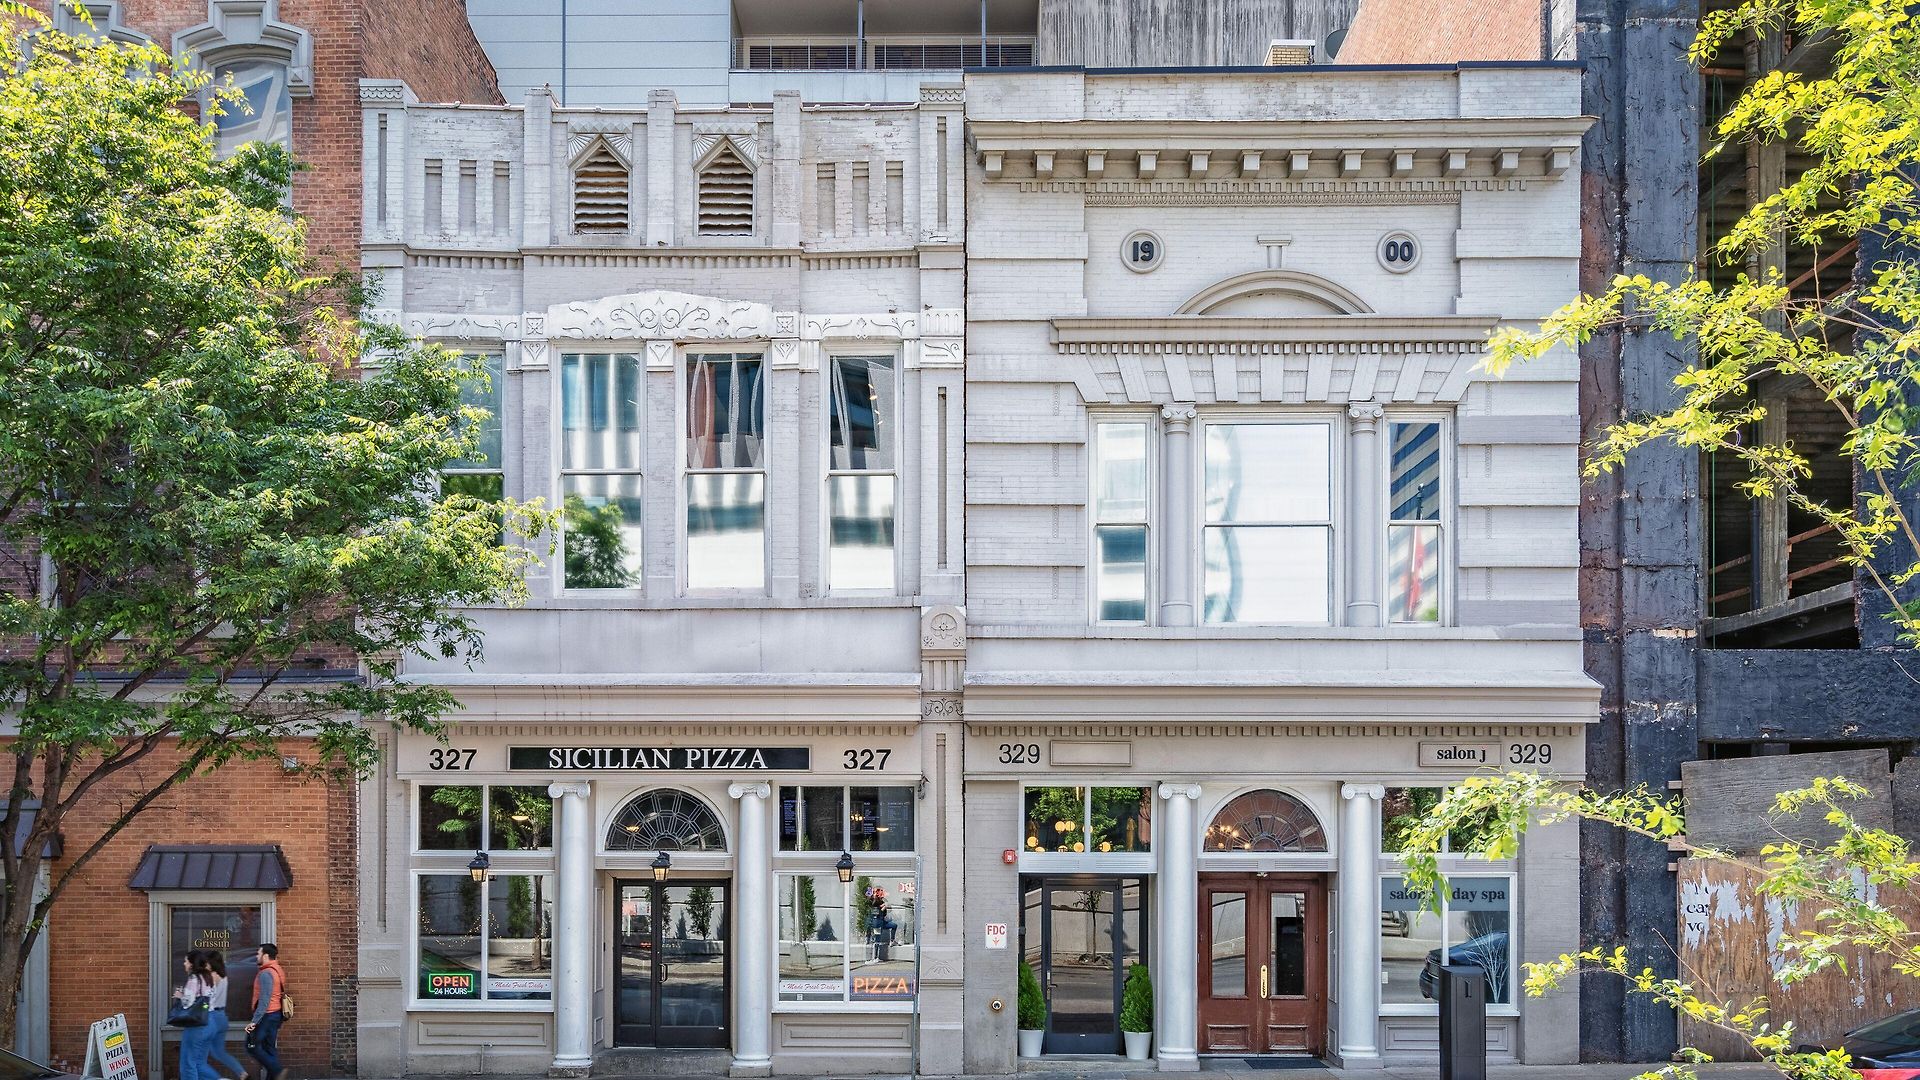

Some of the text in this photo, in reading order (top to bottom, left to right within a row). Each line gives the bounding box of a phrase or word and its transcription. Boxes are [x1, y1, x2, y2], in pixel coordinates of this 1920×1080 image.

[1132, 240, 1414, 262] 19 00
[429, 748, 478, 771] 327
[549, 747, 769, 770] SICILIAN PIZZA
[843, 748, 892, 771] 327
[998, 743, 1041, 765] 329
[1436, 745, 1487, 763] salon j
[1509, 743, 1553, 765] 329
[1452, 887, 1478, 903] day
[1481, 889, 1506, 903] spa
[203, 929, 230, 938] Mitch
[987, 925, 1006, 935] FDC
[432, 976, 470, 988] OPEN
[434, 987, 468, 995] 24 HOURS
[853, 976, 909, 994] PIZZA
[105, 1046, 124, 1061] PIZZA
[109, 1056, 130, 1072] WINGS
